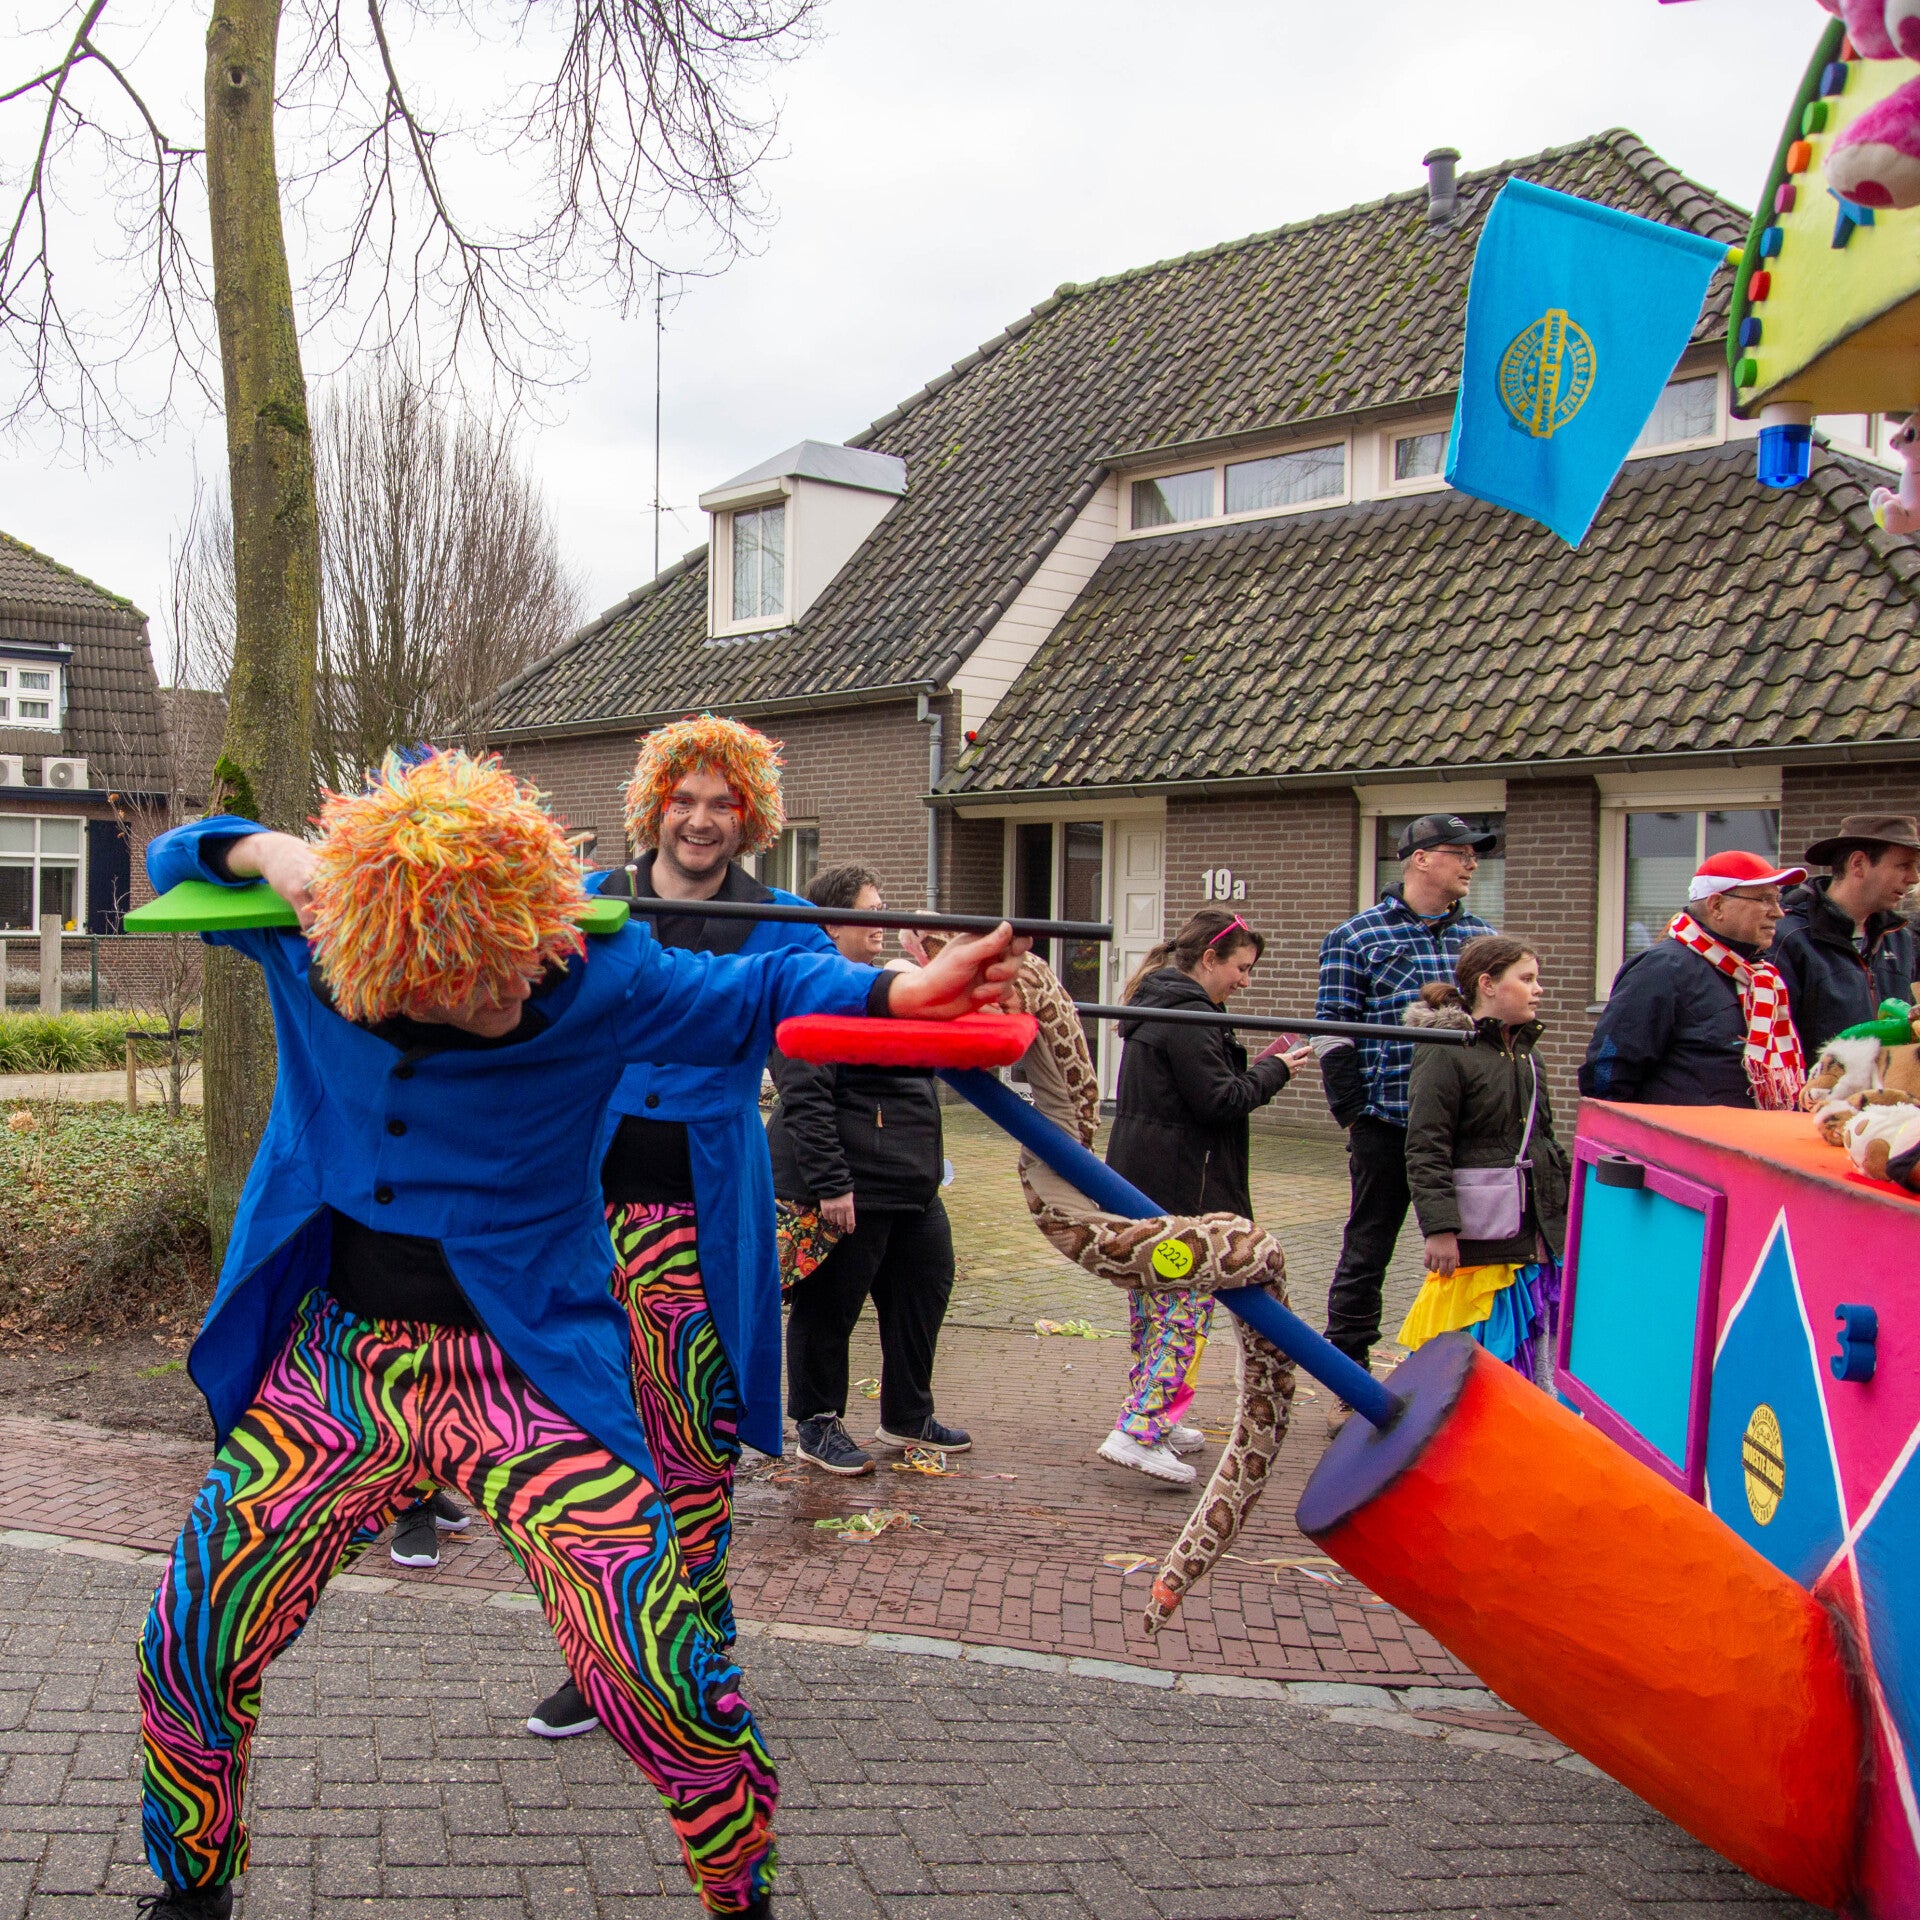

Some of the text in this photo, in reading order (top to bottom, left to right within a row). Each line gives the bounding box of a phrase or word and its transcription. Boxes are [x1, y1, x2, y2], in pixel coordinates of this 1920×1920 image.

[1538, 314, 1561, 432] WOESTE BENDE
[1201, 868, 1246, 900] 19a
[1157, 1242, 1188, 1270] 2222
